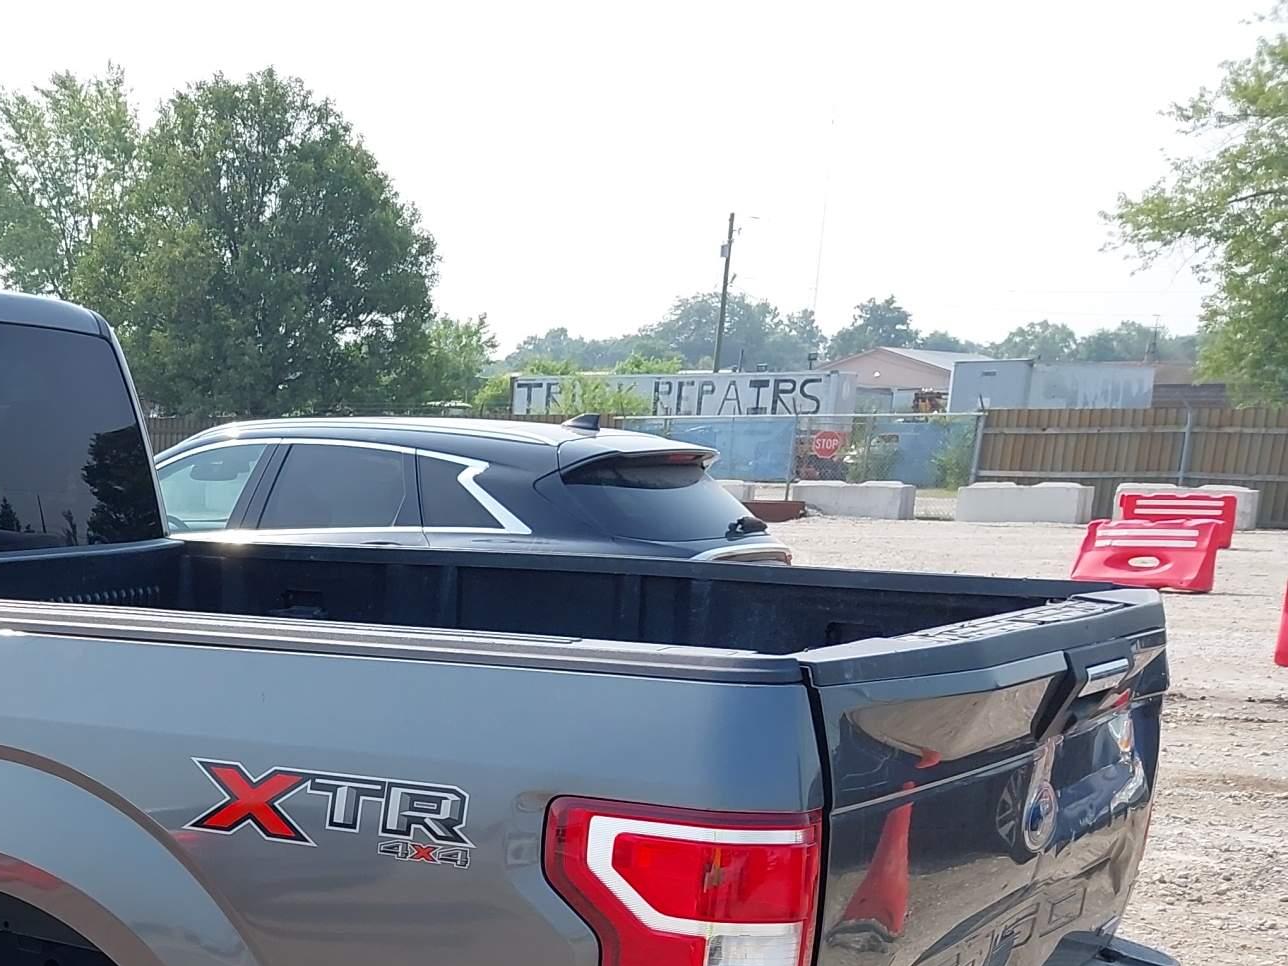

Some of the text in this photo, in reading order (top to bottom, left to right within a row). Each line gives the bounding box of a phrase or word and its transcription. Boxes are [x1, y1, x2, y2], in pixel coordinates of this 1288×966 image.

[652, 377, 823, 416] REPAIRS
[815, 438, 839, 449] STOP
[181, 757, 477, 848] XTR
